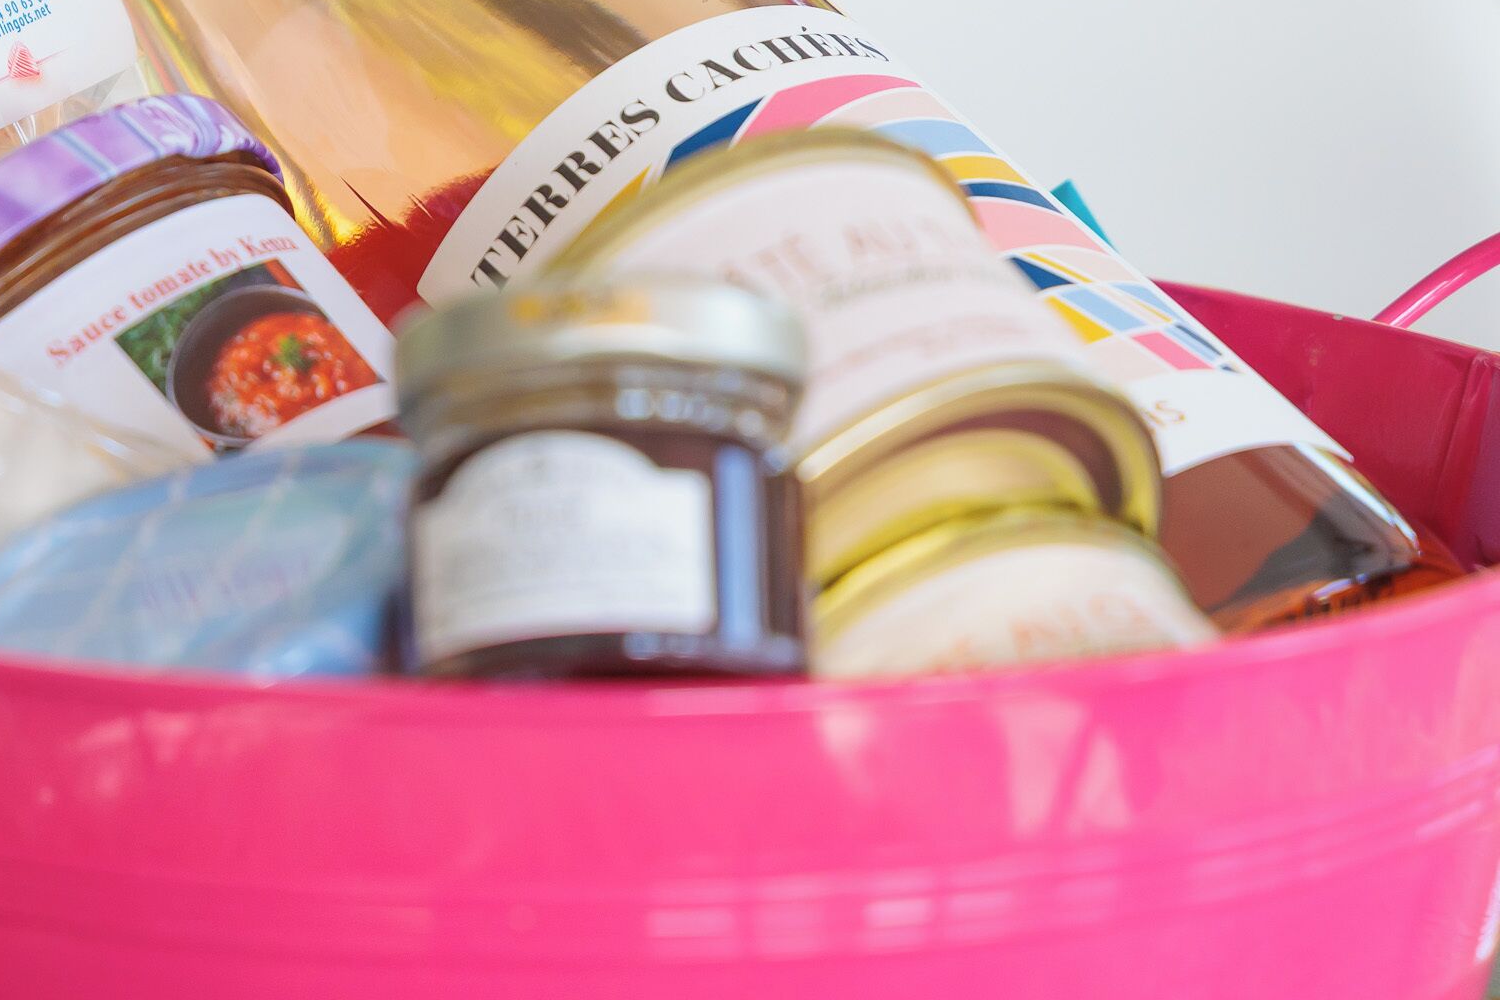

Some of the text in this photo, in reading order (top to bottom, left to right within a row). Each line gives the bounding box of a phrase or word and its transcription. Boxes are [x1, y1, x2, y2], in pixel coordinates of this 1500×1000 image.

[5, 0, 19, 17] 90
[470, 26, 890, 290] TERRES CACHÉES
[47, 303, 129, 369] Sauce
[130, 261, 211, 312] tomate
[211, 243, 244, 273] by
